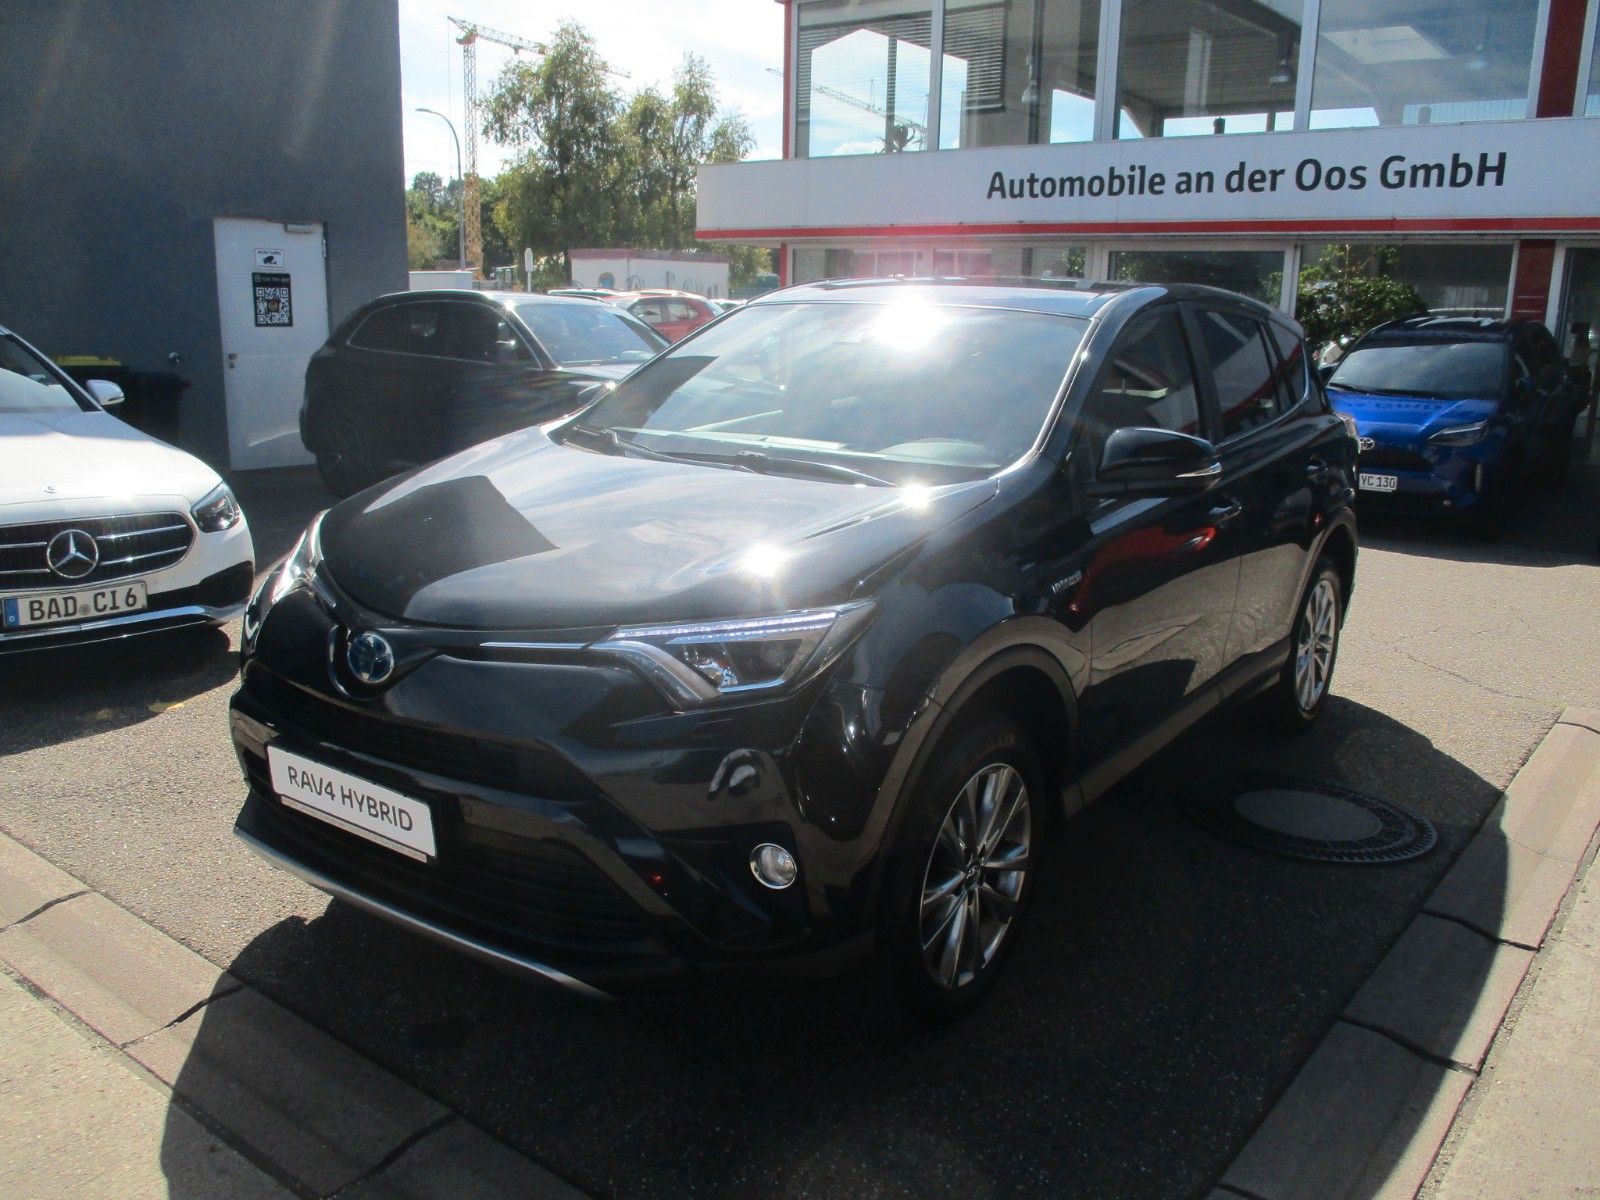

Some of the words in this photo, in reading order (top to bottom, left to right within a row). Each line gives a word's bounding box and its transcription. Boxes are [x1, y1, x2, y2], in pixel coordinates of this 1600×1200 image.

[986, 164, 1166, 200] Automobile
[1174, 169, 1215, 194] an
[1224, 161, 1286, 193] der
[1295, 157, 1368, 192] Oos
[1379, 151, 1508, 190] GmbH
[1376, 476, 1396, 489] 130
[29, 596, 78, 622] BAD
[287, 765, 336, 801] RAV4
[340, 784, 413, 832] HYBRID
